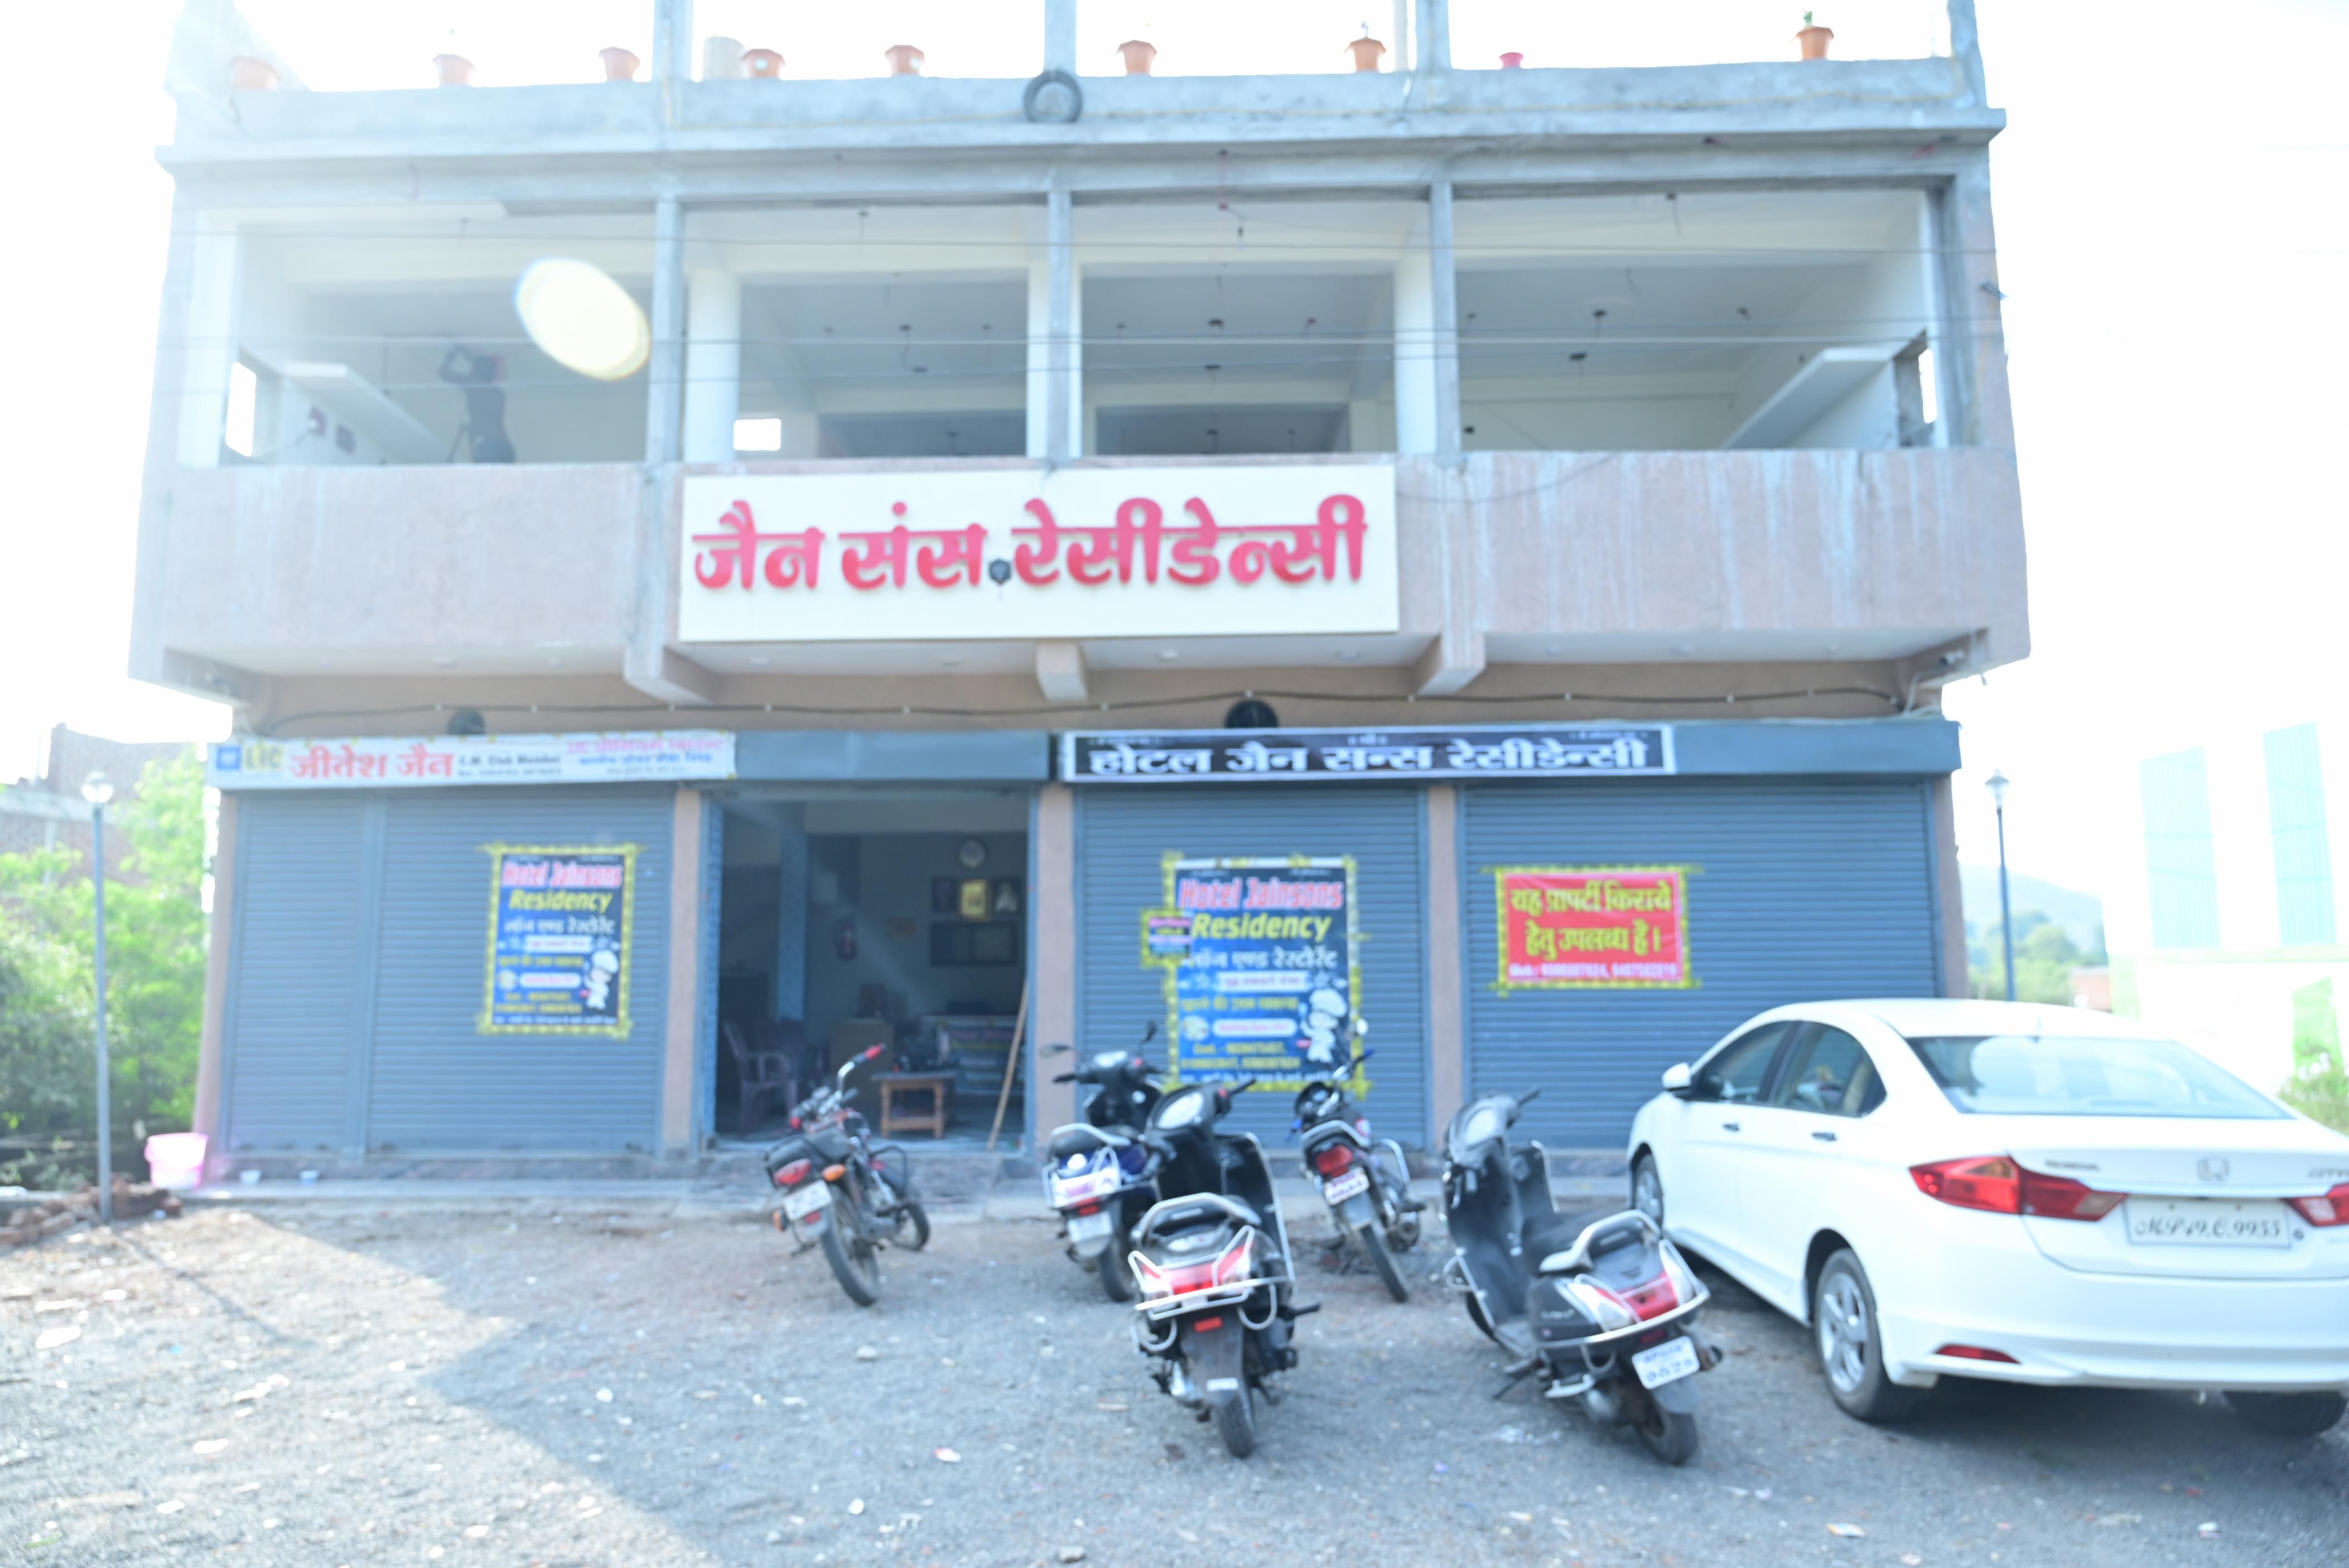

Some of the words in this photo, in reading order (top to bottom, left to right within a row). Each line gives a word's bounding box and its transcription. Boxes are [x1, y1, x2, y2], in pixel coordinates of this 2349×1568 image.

[692, 500, 826, 590] जैन
[838, 501, 988, 590] संस
[1012, 494, 1368, 586] रेसीडेन्सी
[291, 745, 389, 778] जीतेश
[397, 744, 455, 777] जैन
[1087, 742, 1214, 775] होटल
[1224, 740, 1310, 773] जैन
[1320, 745, 1434, 771] सन्स
[509, 889, 613, 914] Residency
[1178, 877, 1242, 909] Hotel
[1243, 876, 1344, 910] Jainsons
[1510, 887, 1543, 918] यह
[1192, 912, 1332, 943] Residency
[1524, 918, 1558, 961] हेतु
